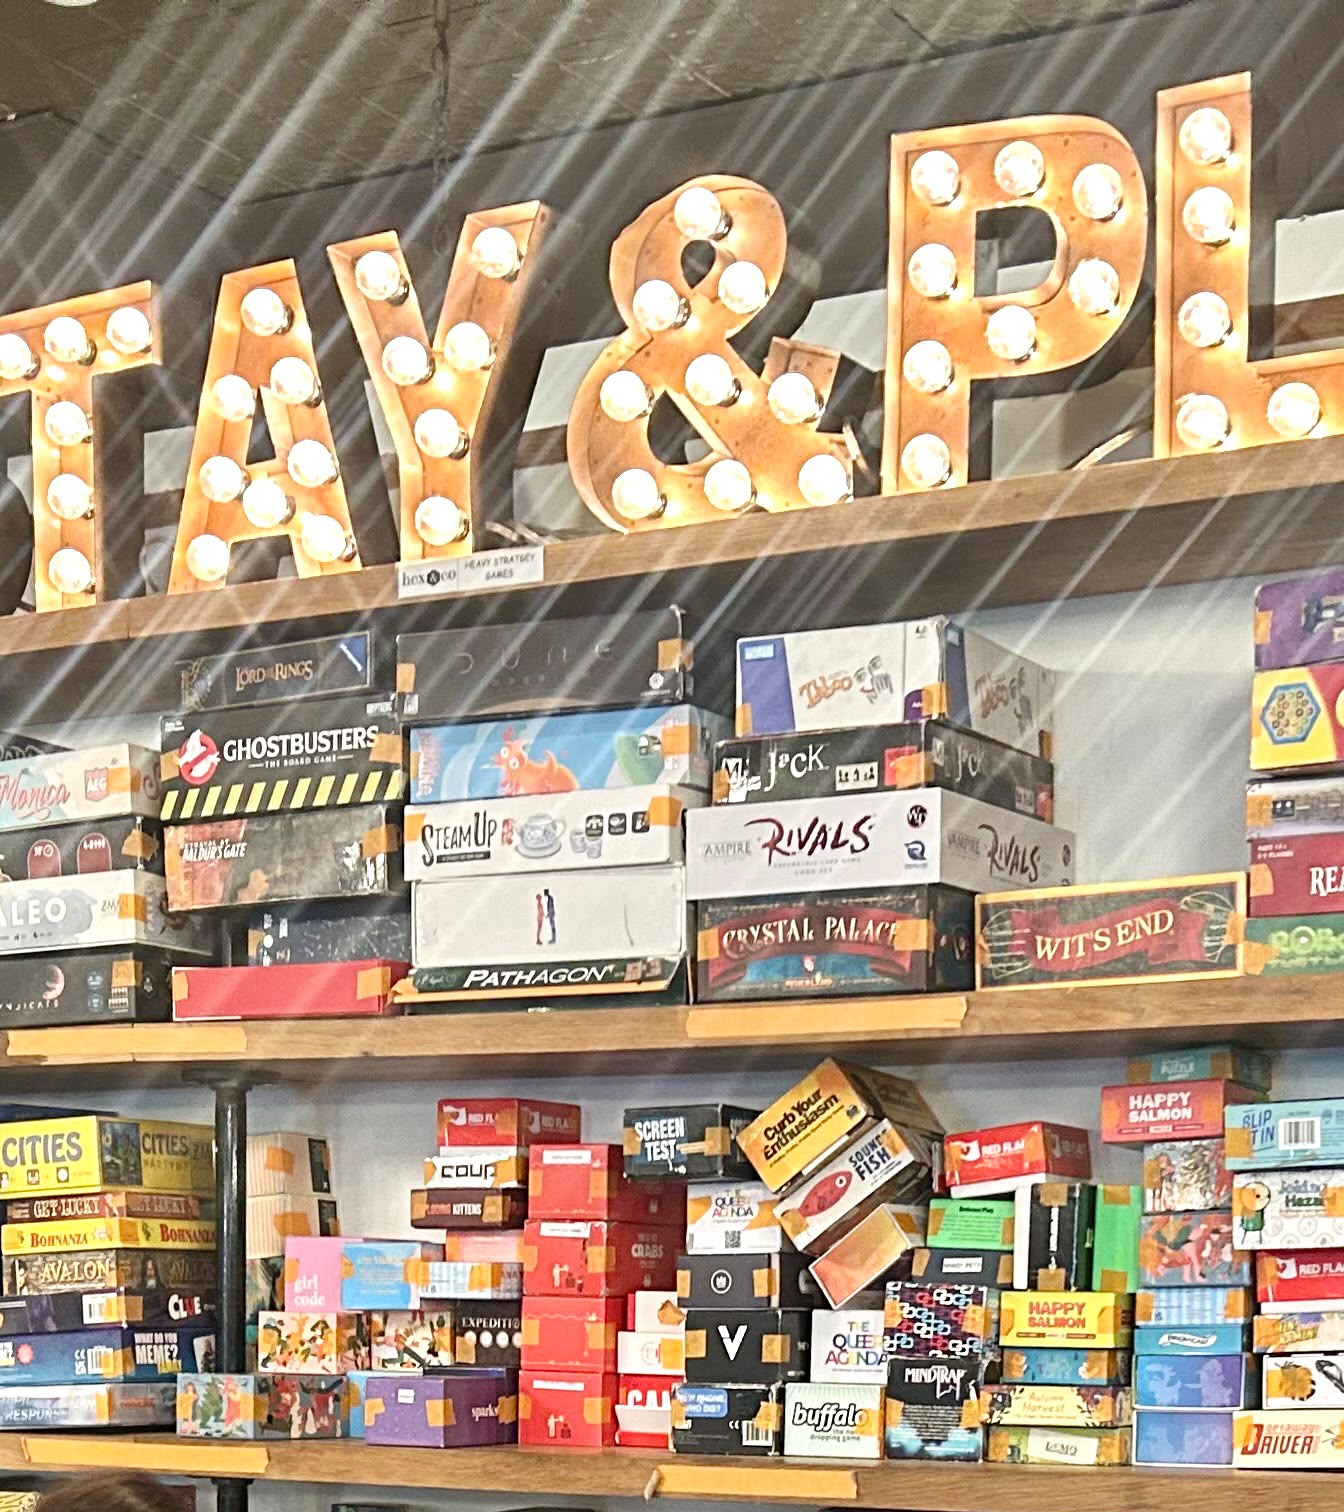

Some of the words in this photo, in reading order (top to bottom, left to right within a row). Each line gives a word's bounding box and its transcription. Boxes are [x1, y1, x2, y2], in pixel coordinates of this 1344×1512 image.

[464, 559, 490, 570] HEAVY
[486, 570, 514, 581] GAMES
[223, 726, 379, 762] GHOSTBUSTERS
[86, 776, 107, 793] AEG
[1033, 930, 1111, 962] WIT'S
[1116, 908, 1175, 948] END
[464, 966, 606, 988] PATHAGON
[1128, 1091, 1192, 1110] HAPPY
[763, 1111, 795, 1141] Curb
[794, 1088, 823, 1118] Your
[1128, 1107, 1193, 1122] SALMON
[634, 1117, 685, 1141] SCREEN
[763, 1092, 840, 1162] Enthusiasm
[1, 1132, 83, 1168] CITIES
[141, 1133, 189, 1156] CITIES
[644, 1140, 677, 1161] TEST
[856, 1149, 891, 1182] FISH
[451, 1203, 482, 1216] KITTENS
[30, 1232, 88, 1248] BOHNANZA
[41, 1258, 110, 1283] AVALON
[293, 1276, 318, 1291] girl
[167, 1294, 202, 1320] CLUE
[293, 1292, 324, 1307] code
[1028, 1301, 1087, 1317] HAPPY
[1028, 1316, 1086, 1329] SALMON
[135, 1344, 179, 1364] MEME?
[792, 1403, 869, 1433] buffalo
